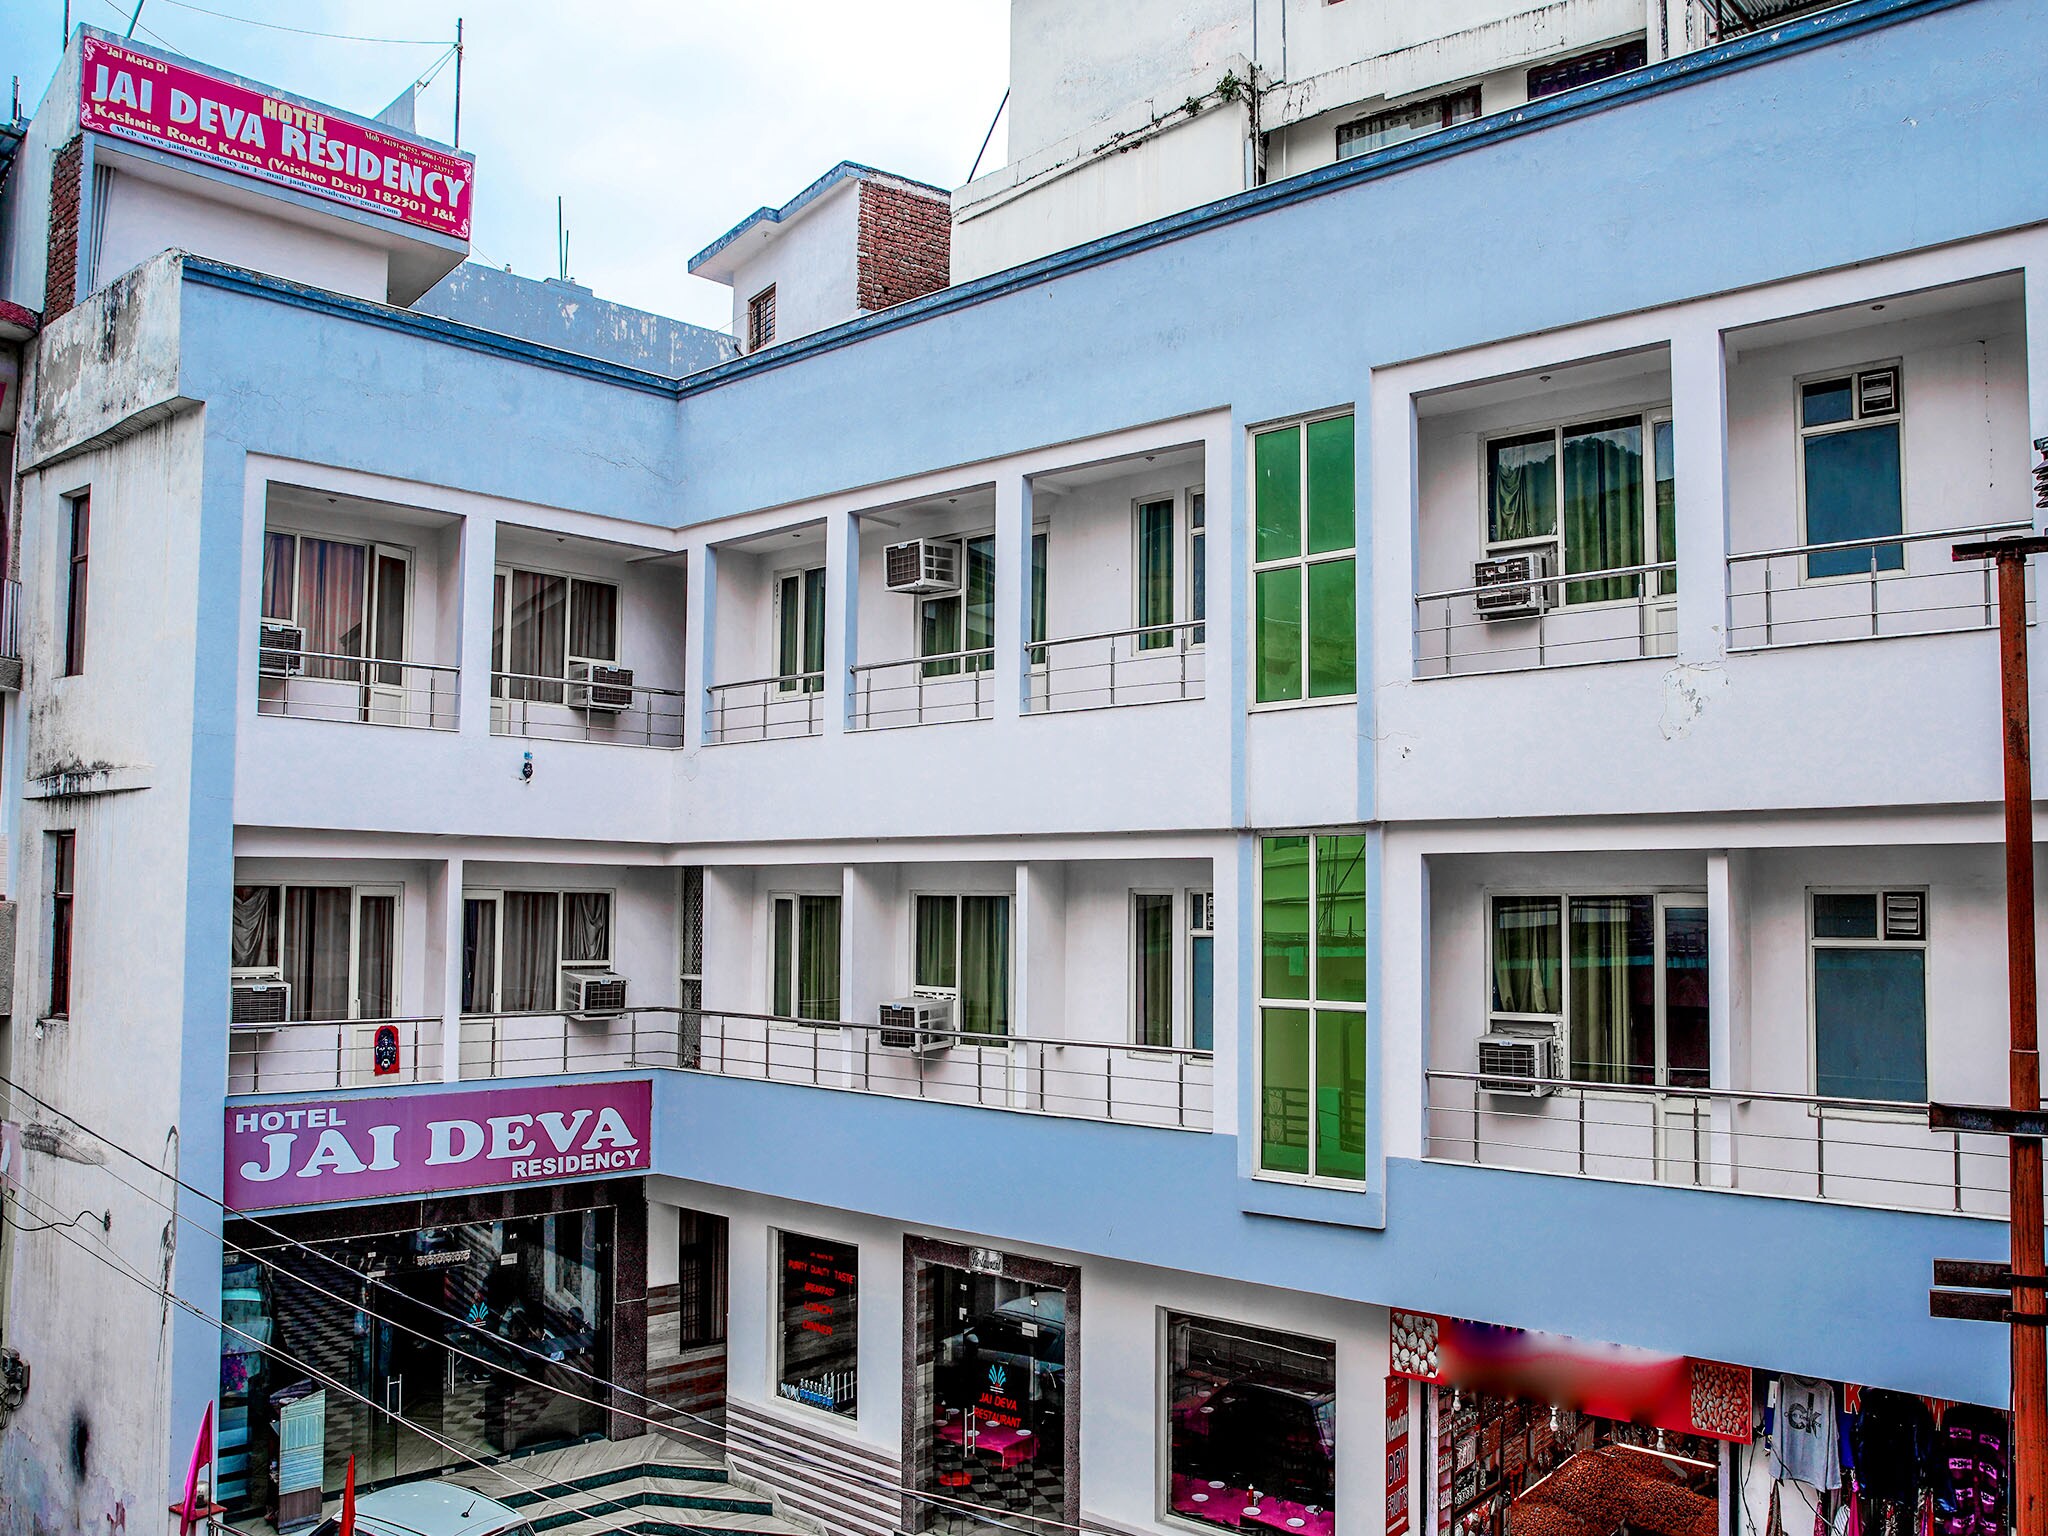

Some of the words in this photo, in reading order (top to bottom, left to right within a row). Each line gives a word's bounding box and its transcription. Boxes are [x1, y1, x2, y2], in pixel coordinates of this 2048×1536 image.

[107, 46, 122, 59] Jai
[126, 53, 154, 70] Mata
[156, 61, 168, 74] Di
[263, 98, 327, 137] HOTEL
[91, 63, 153, 114] JAI
[170, 87, 266, 149] DEVA
[281, 124, 465, 208] RESIDENCY
[94, 103, 161, 134] Kashmir
[167, 125, 212, 151] Road,
[268, 157, 326, 184] (Vaishno
[331, 176, 367, 199] Devi)
[373, 188, 426, 214] 182301
[235, 1107, 347, 1134] HOTEL
[239, 1125, 401, 1182] JAI
[424, 1106, 639, 1167] DEVA
[512, 1148, 641, 1179] RESIDENCY
[804, 1281, 835, 1297] BREAKFAST
[834, 1270, 854, 1285] TASTE
[803, 1300, 833, 1315] LUNCH
[801, 1319, 833, 1337] DINNER
[979, 1392, 993, 1405] JAI
[994, 1396, 1017, 1411] DEVA
[974, 1407, 1022, 1429] RESTAURANT
[1387, 1443, 1408, 1488] DRY
[1386, 1483, 1408, 1521] FRUITS
